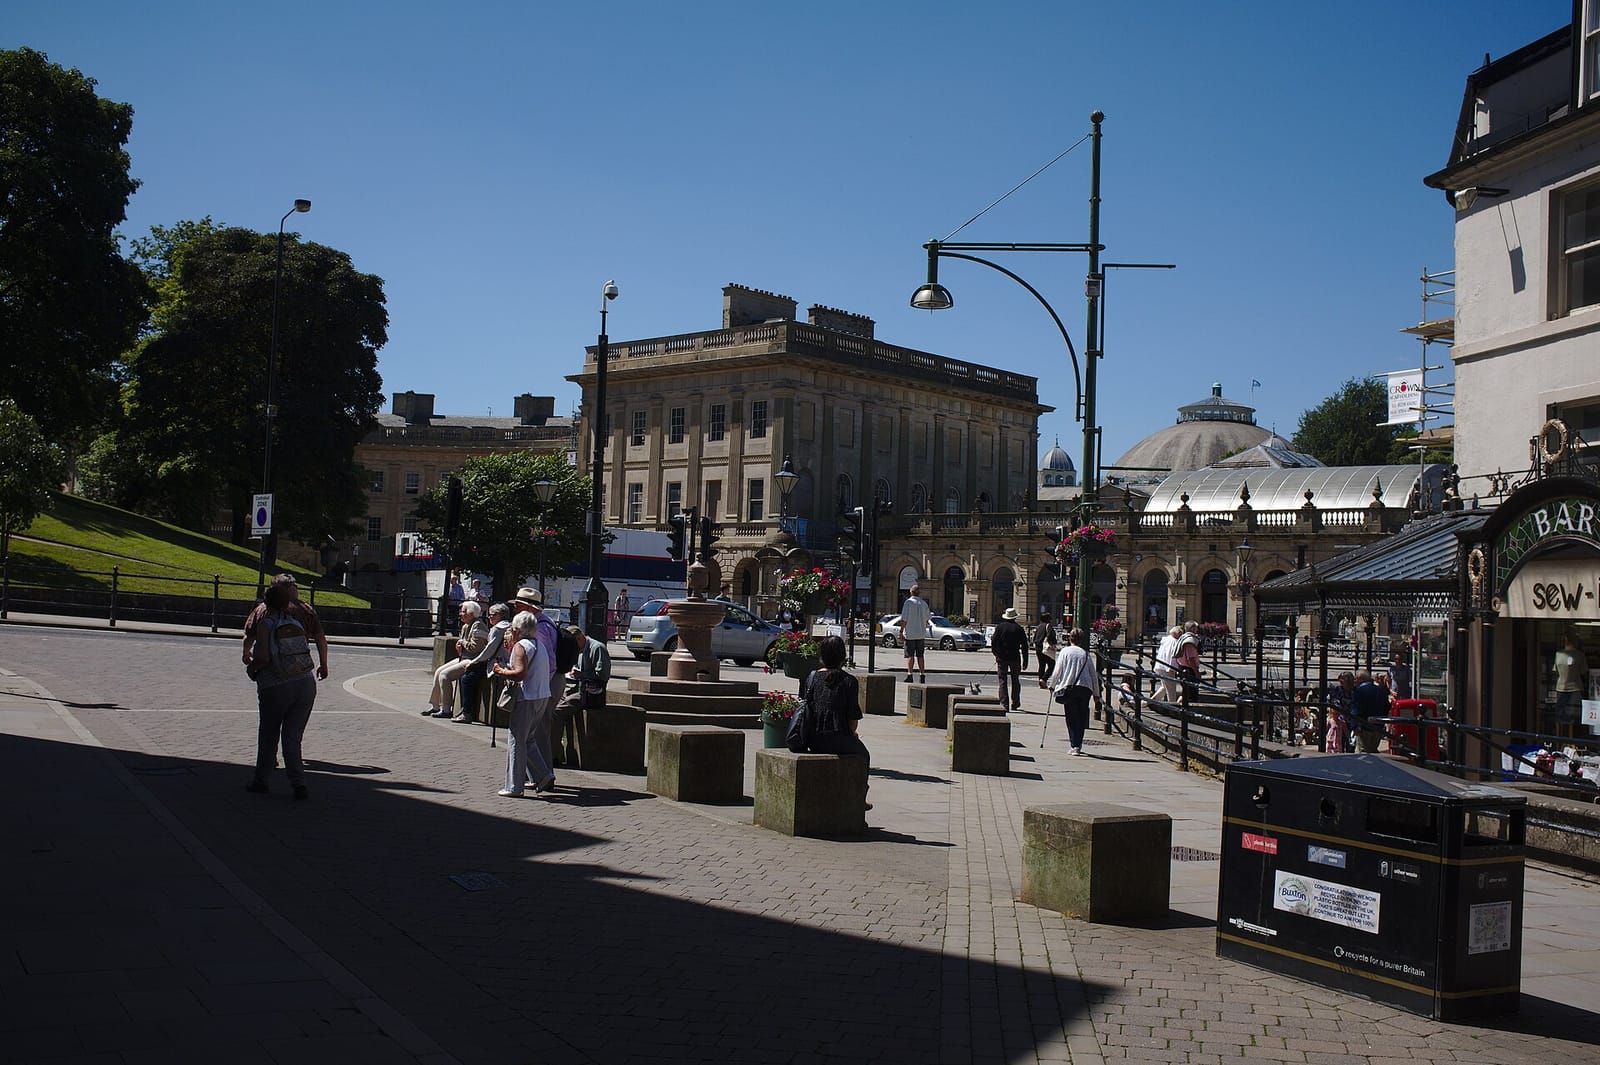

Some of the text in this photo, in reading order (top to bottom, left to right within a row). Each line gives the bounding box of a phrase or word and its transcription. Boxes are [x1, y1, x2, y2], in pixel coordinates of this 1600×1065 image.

[1390, 383, 1420, 394] CROWN
[1032, 517, 1069, 527] BUXTON
[1533, 501, 1594, 538] BAR
[1282, 887, 1307, 901] Buxton
[1314, 896, 1331, 904] PLASTIC
[1314, 908, 1336, 918] CONTINUE
[1345, 951, 1369, 963] recycle
[1370, 955, 1379, 965] for
[1385, 961, 1402, 971] purer
[1403, 964, 1426, 977] Britain
